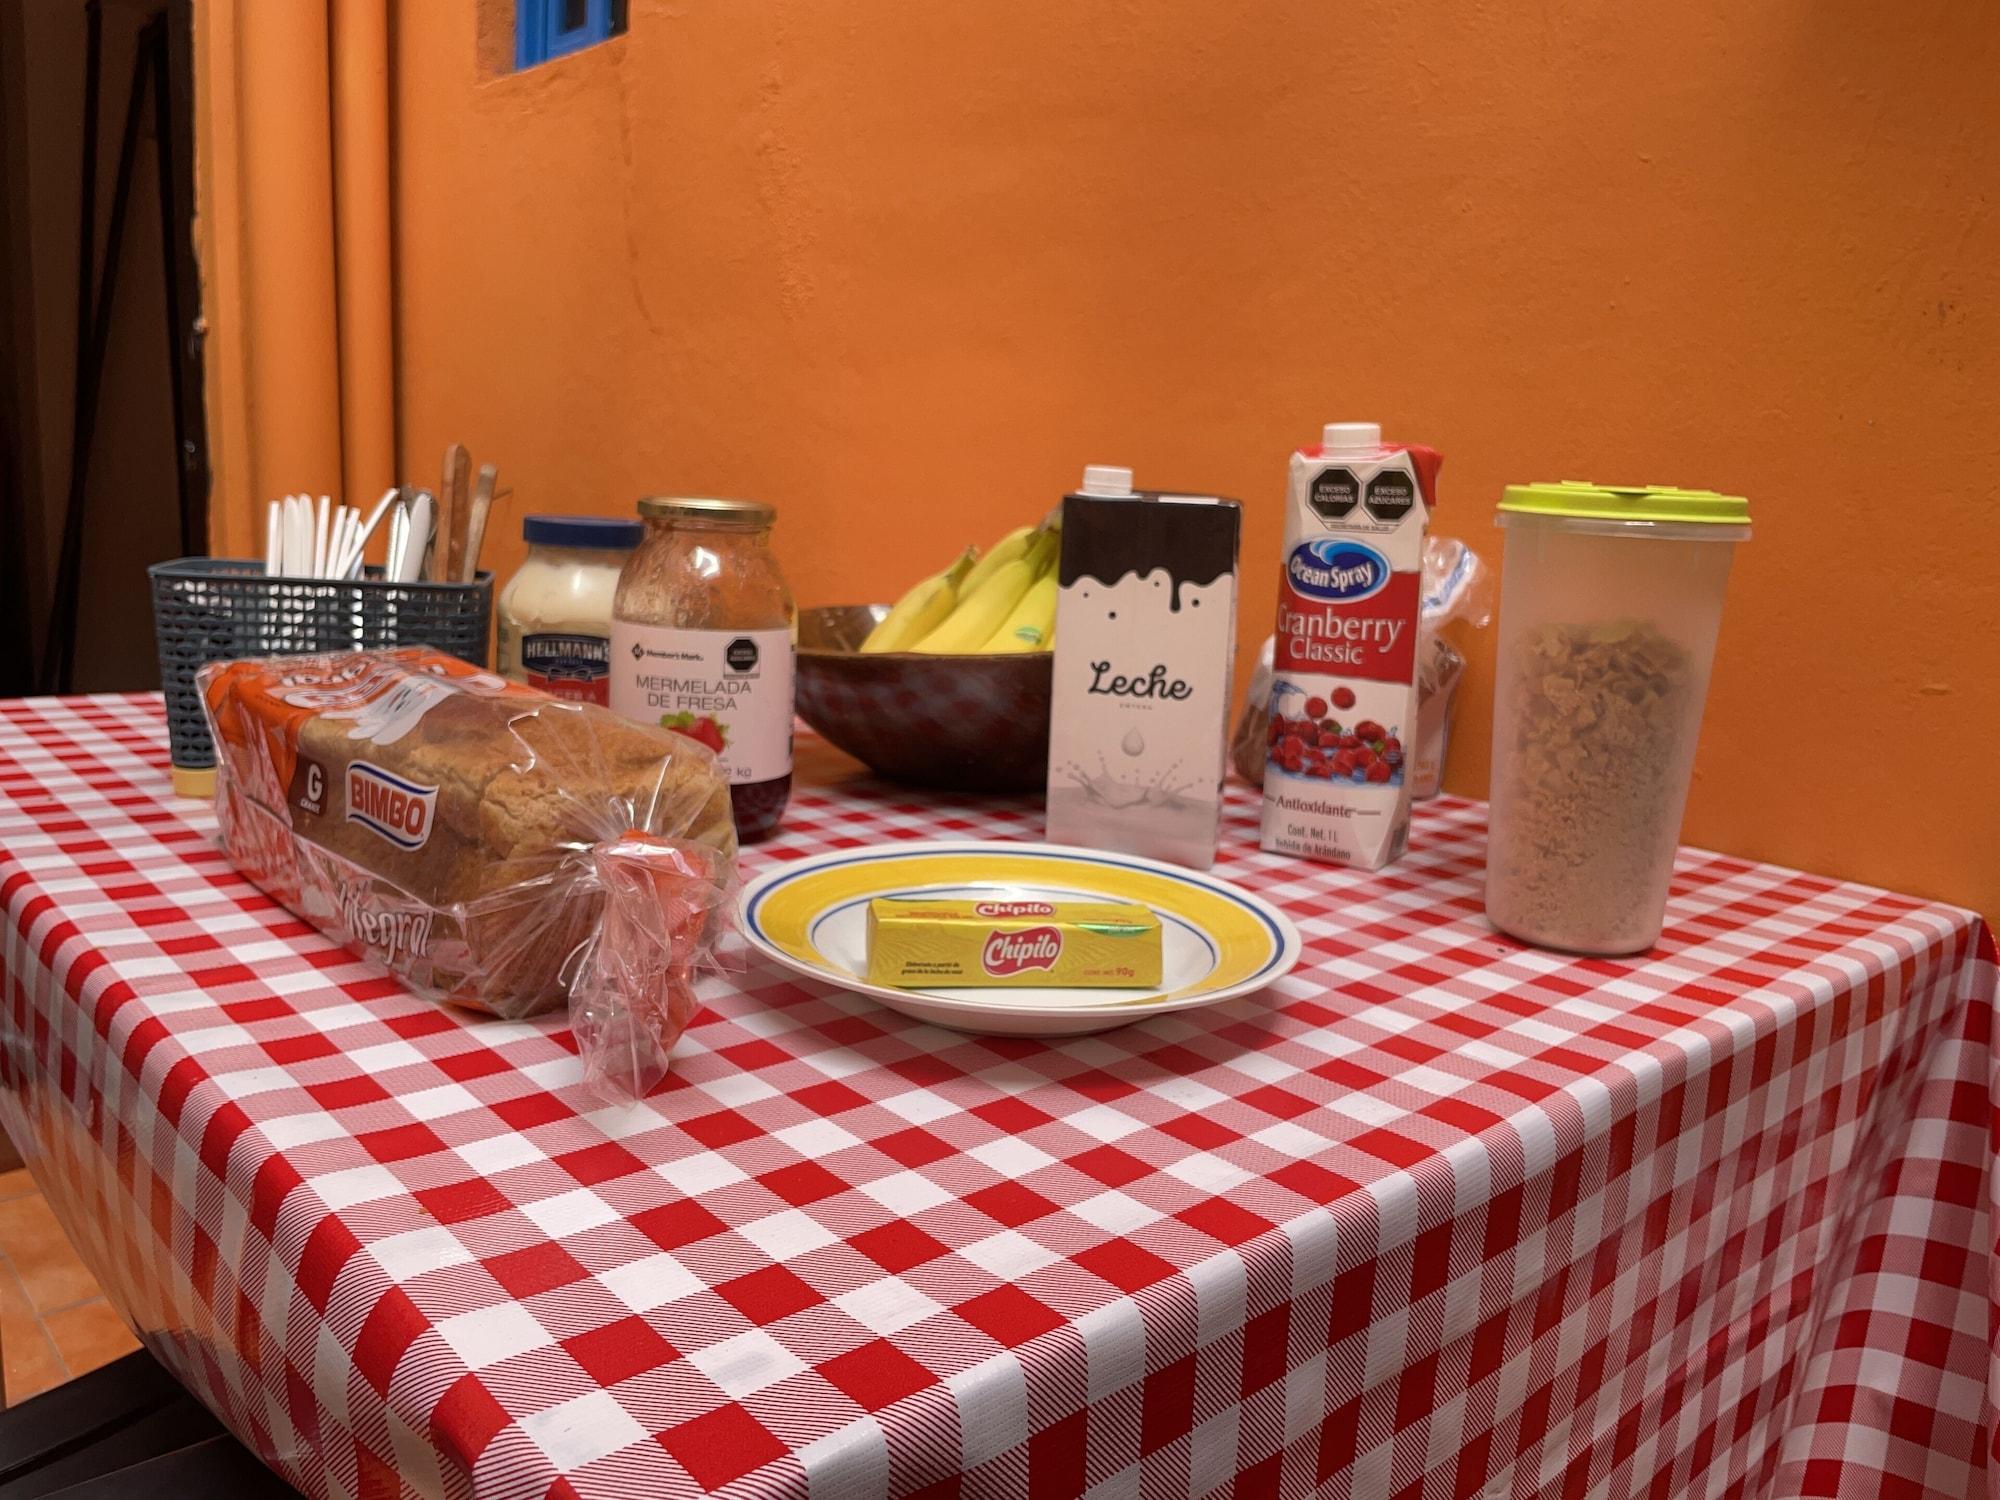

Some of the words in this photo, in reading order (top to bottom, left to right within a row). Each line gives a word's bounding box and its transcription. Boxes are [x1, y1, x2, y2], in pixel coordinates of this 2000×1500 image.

[1290, 555, 1329, 588] Ocean
[1331, 562, 1373, 593] Spray
[1279, 603, 1402, 653] Cranberry
[1290, 637, 1364, 665] Classic
[636, 674, 752, 696] MERMELADA
[1088, 660, 1193, 700] Leche
[648, 693, 670, 708] DE
[677, 695, 738, 711] FRESA
[307, 763, 323, 801] G
[351, 773, 426, 836] BIMBO
[1276, 795, 1352, 819] Antioxidante
[978, 903, 1052, 915] Chipilo
[984, 934, 1060, 968] Chipilo
